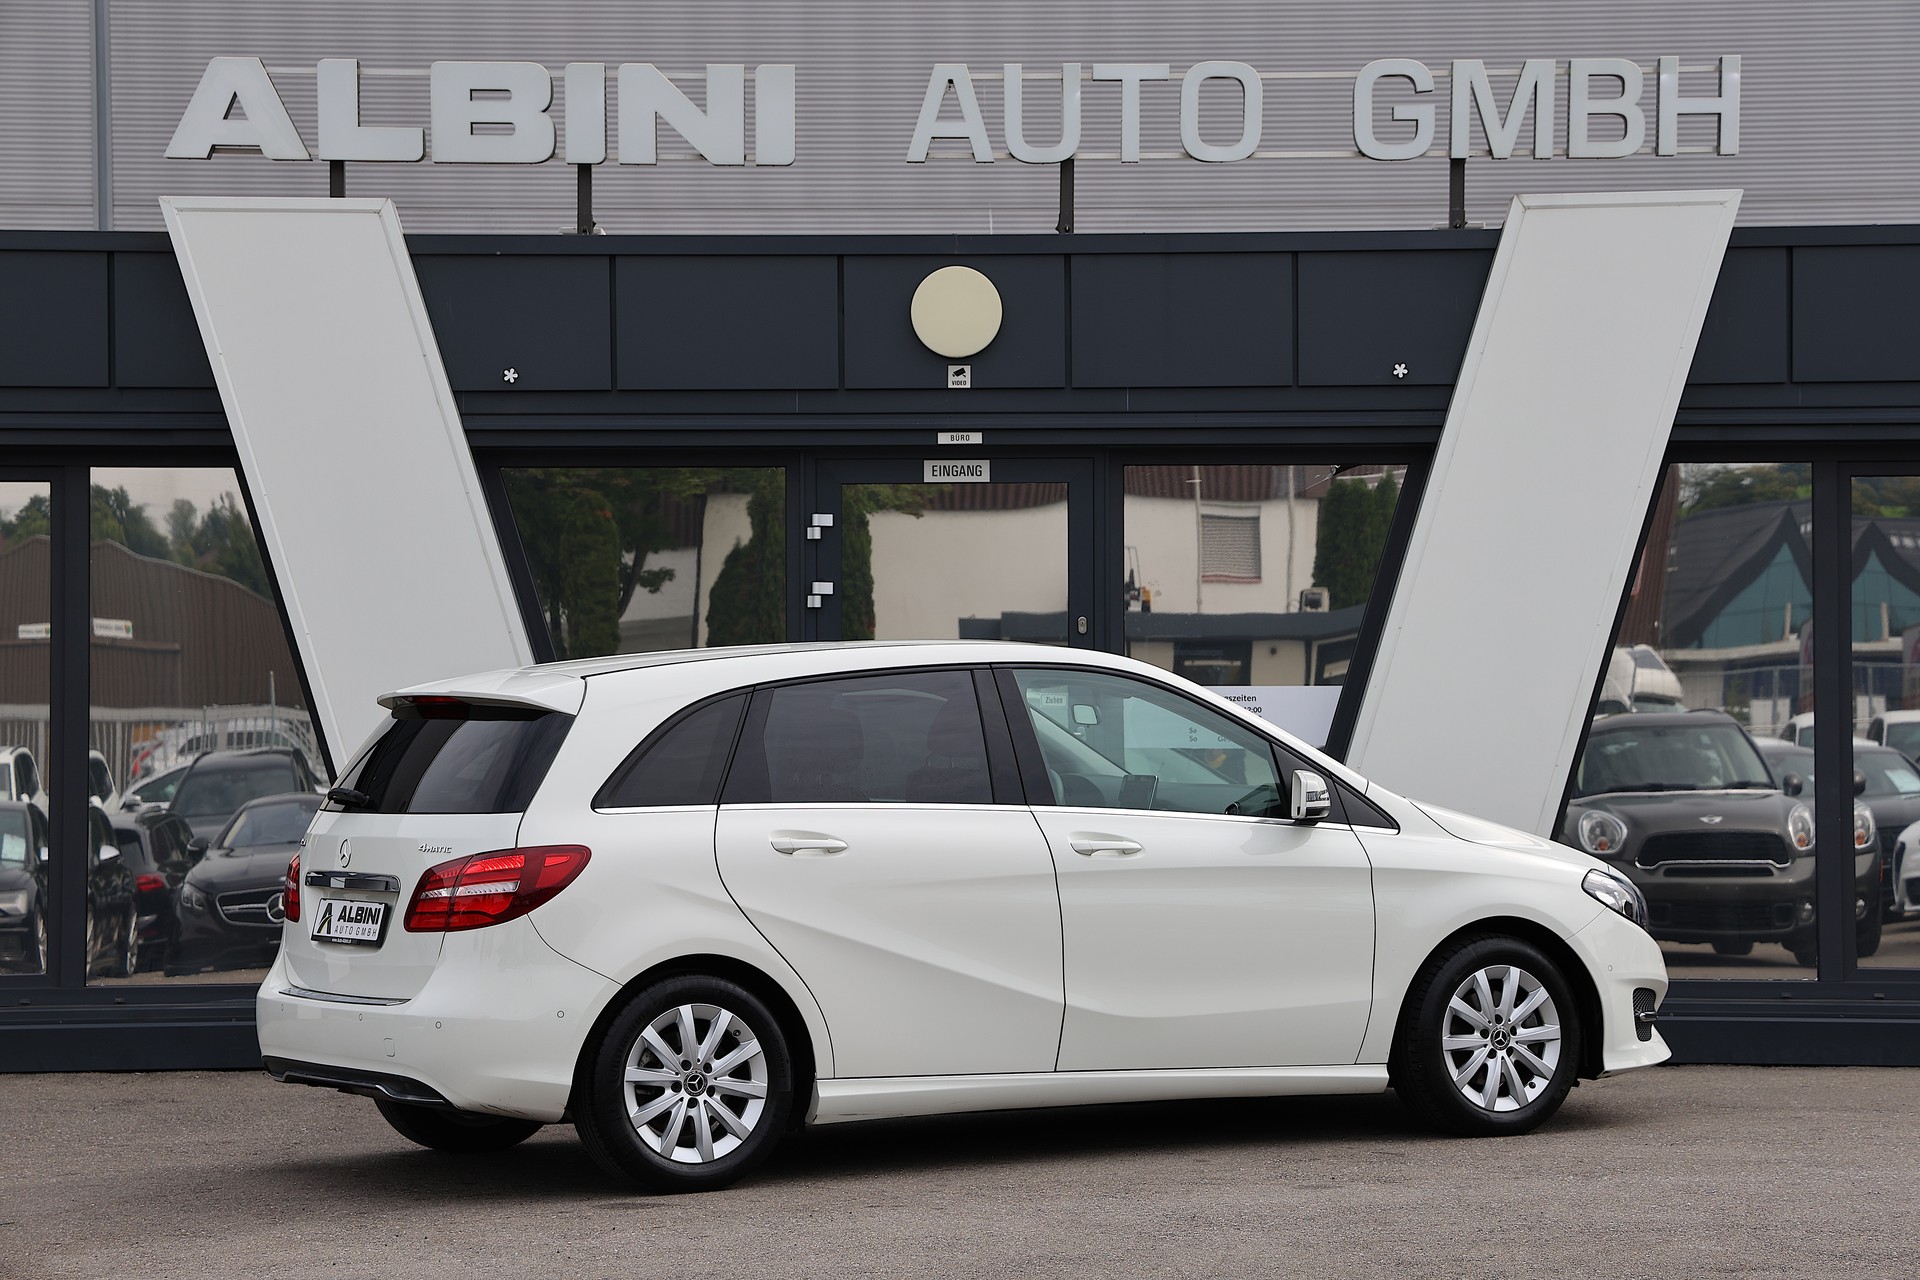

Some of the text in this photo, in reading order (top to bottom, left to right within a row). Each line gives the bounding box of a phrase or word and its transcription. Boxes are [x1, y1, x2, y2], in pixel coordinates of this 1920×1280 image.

[164, 54, 1741, 166] ALBINI AUTO GMBH
[931, 464, 983, 477] EINGANG
[337, 905, 382, 926] ALBINI
[333, 925, 378, 938] AUTO GMBH
